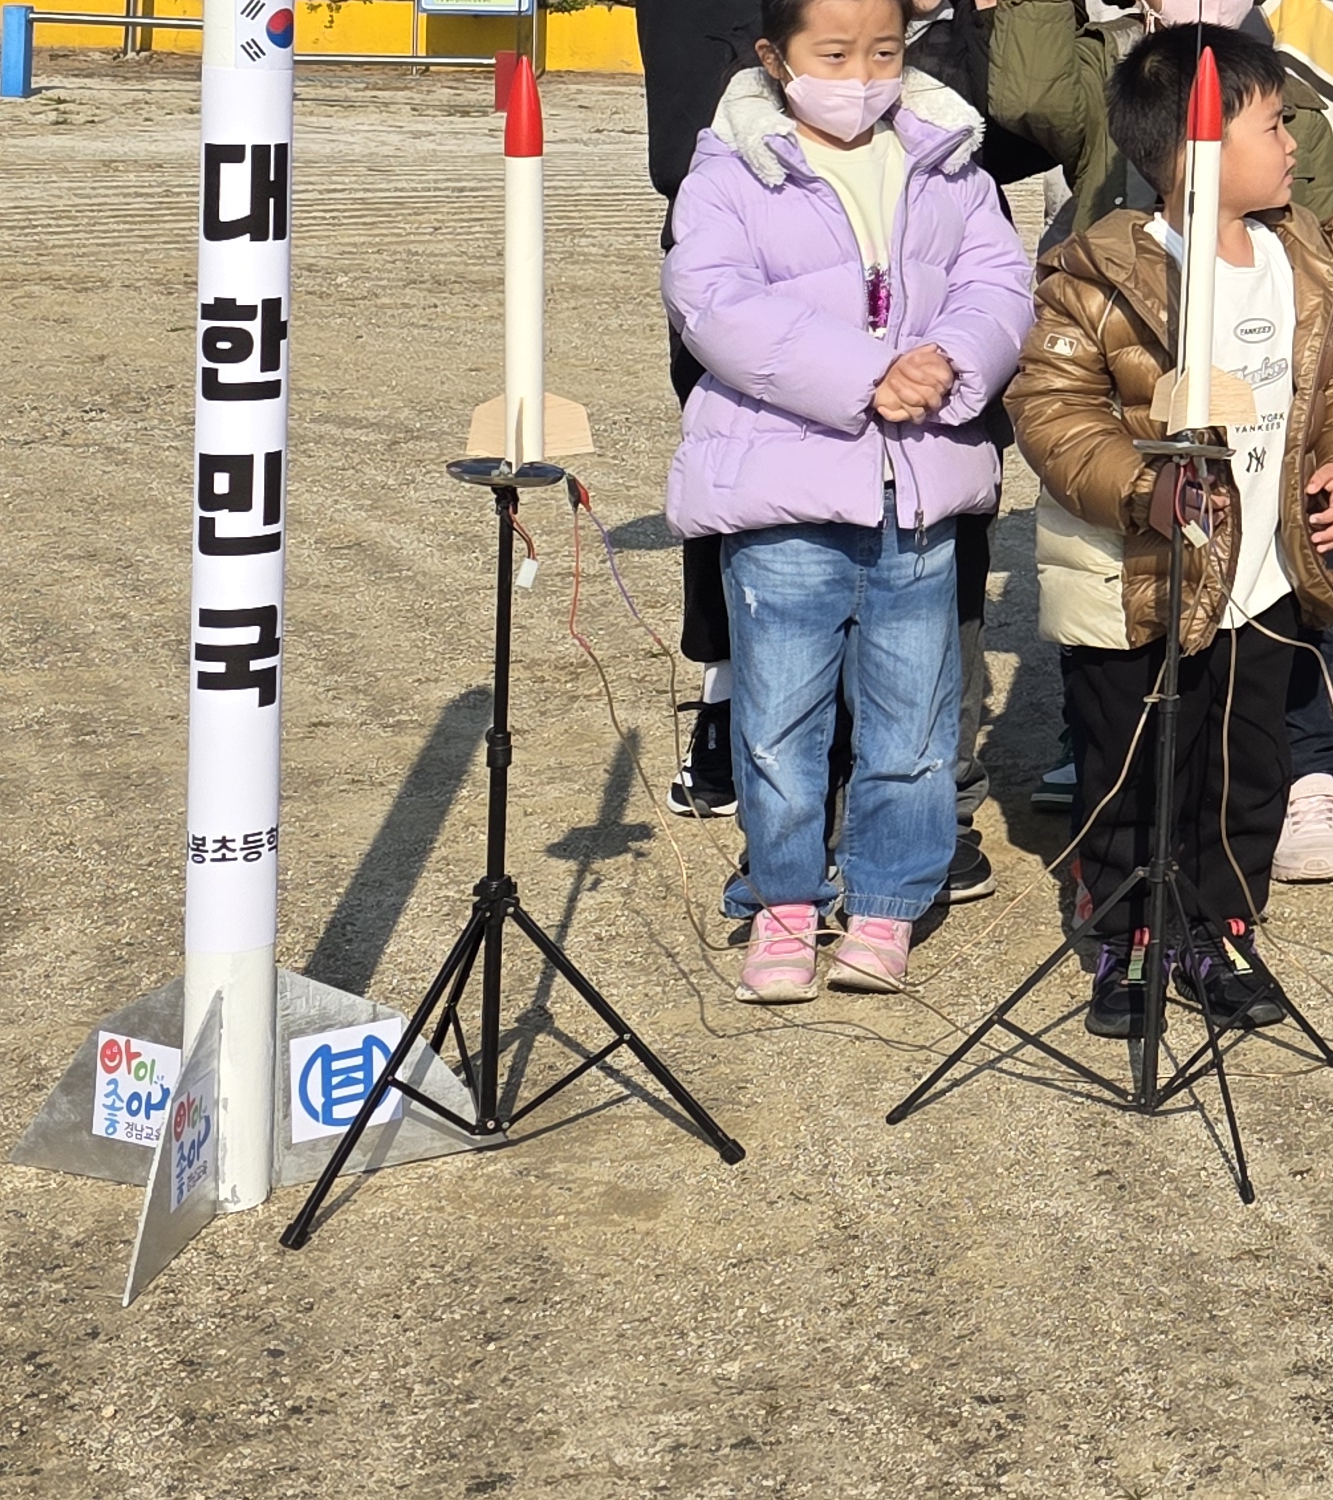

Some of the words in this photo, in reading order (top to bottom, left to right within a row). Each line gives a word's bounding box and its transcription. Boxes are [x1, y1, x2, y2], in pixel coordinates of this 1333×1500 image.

[194, 142, 289, 708] 대한민국
[1234, 421, 1282, 435] YANKEES
[187, 822, 279, 864] 봉초등학
